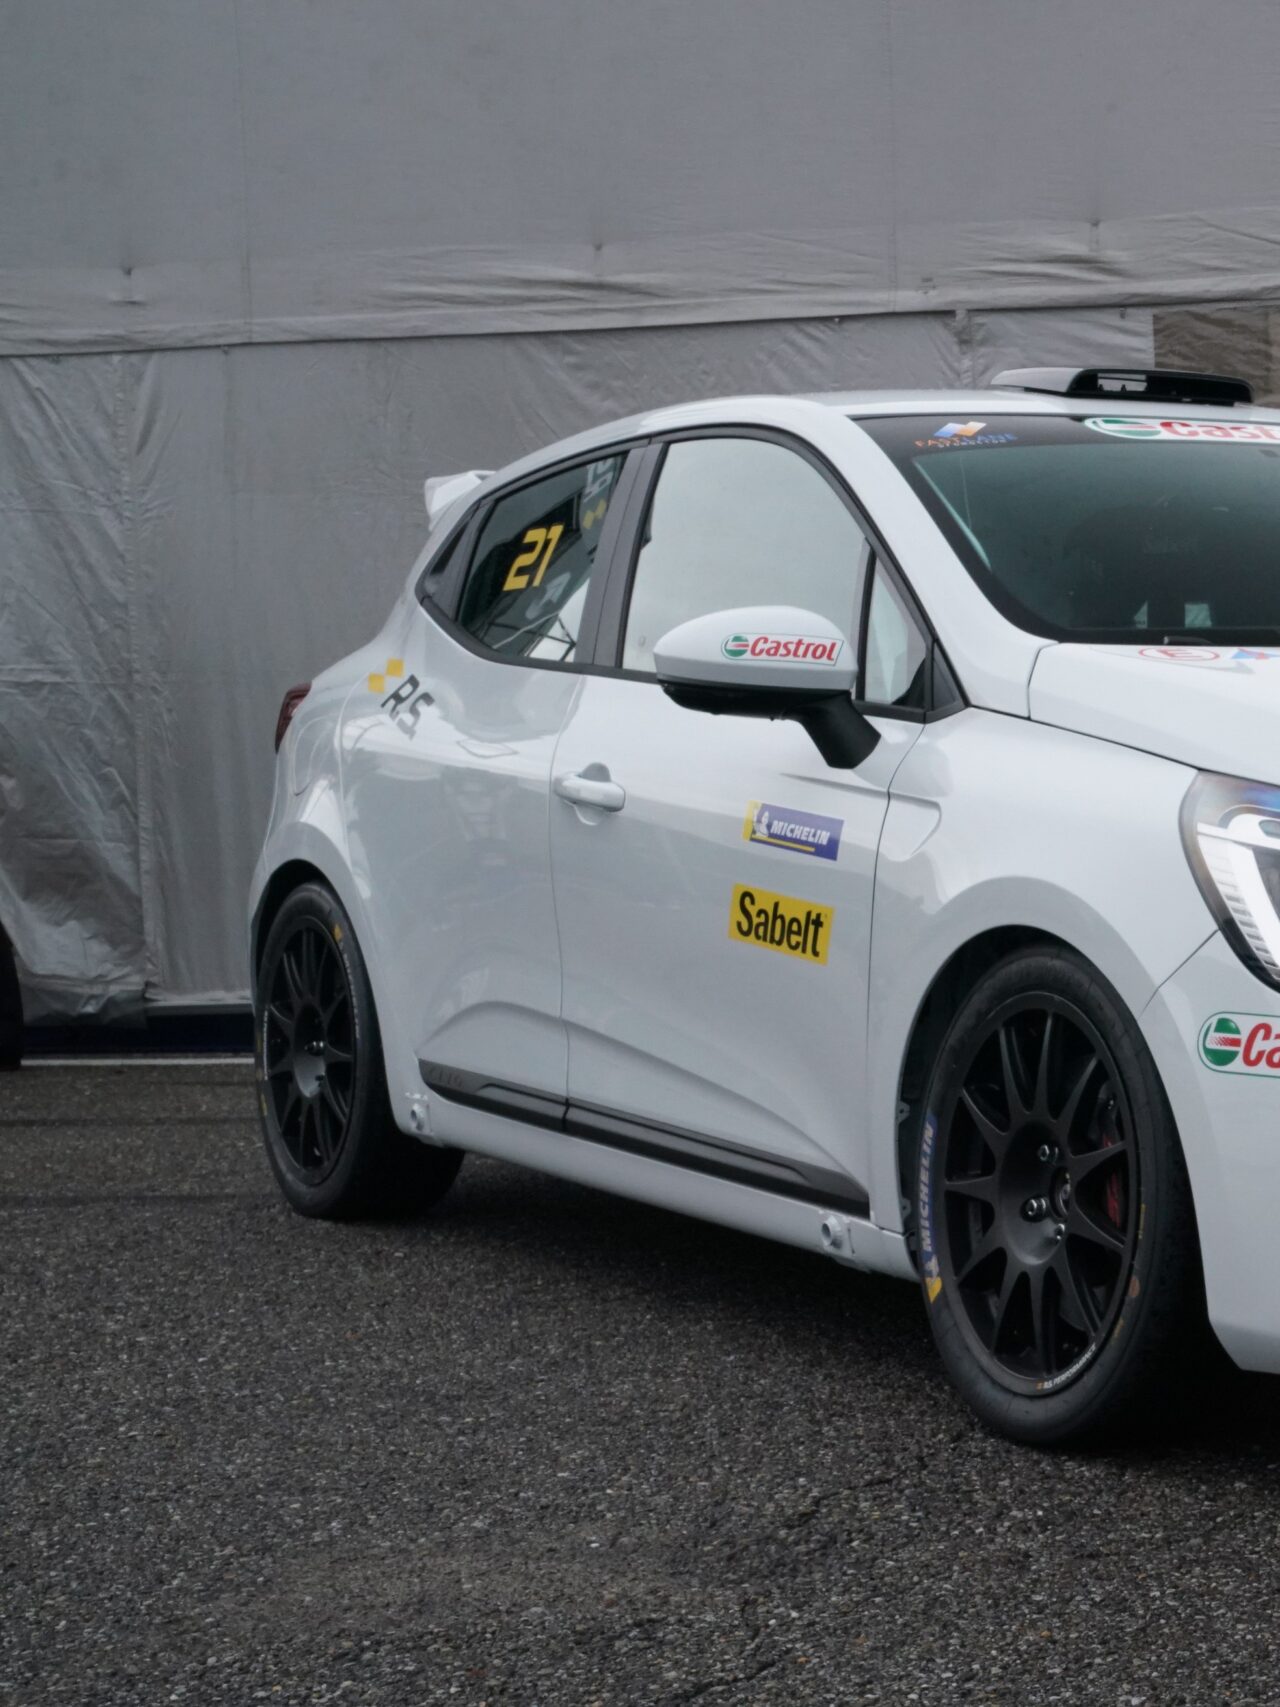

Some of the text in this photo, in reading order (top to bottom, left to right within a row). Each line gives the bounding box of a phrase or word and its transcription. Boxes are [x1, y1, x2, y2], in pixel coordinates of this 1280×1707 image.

[502, 522, 564, 591] 21
[750, 636, 837, 662] Castrol
[770, 819, 831, 846] MICHELIN
[736, 890, 824, 958] Sabelt
[918, 1120, 935, 1252] MICHELIN
